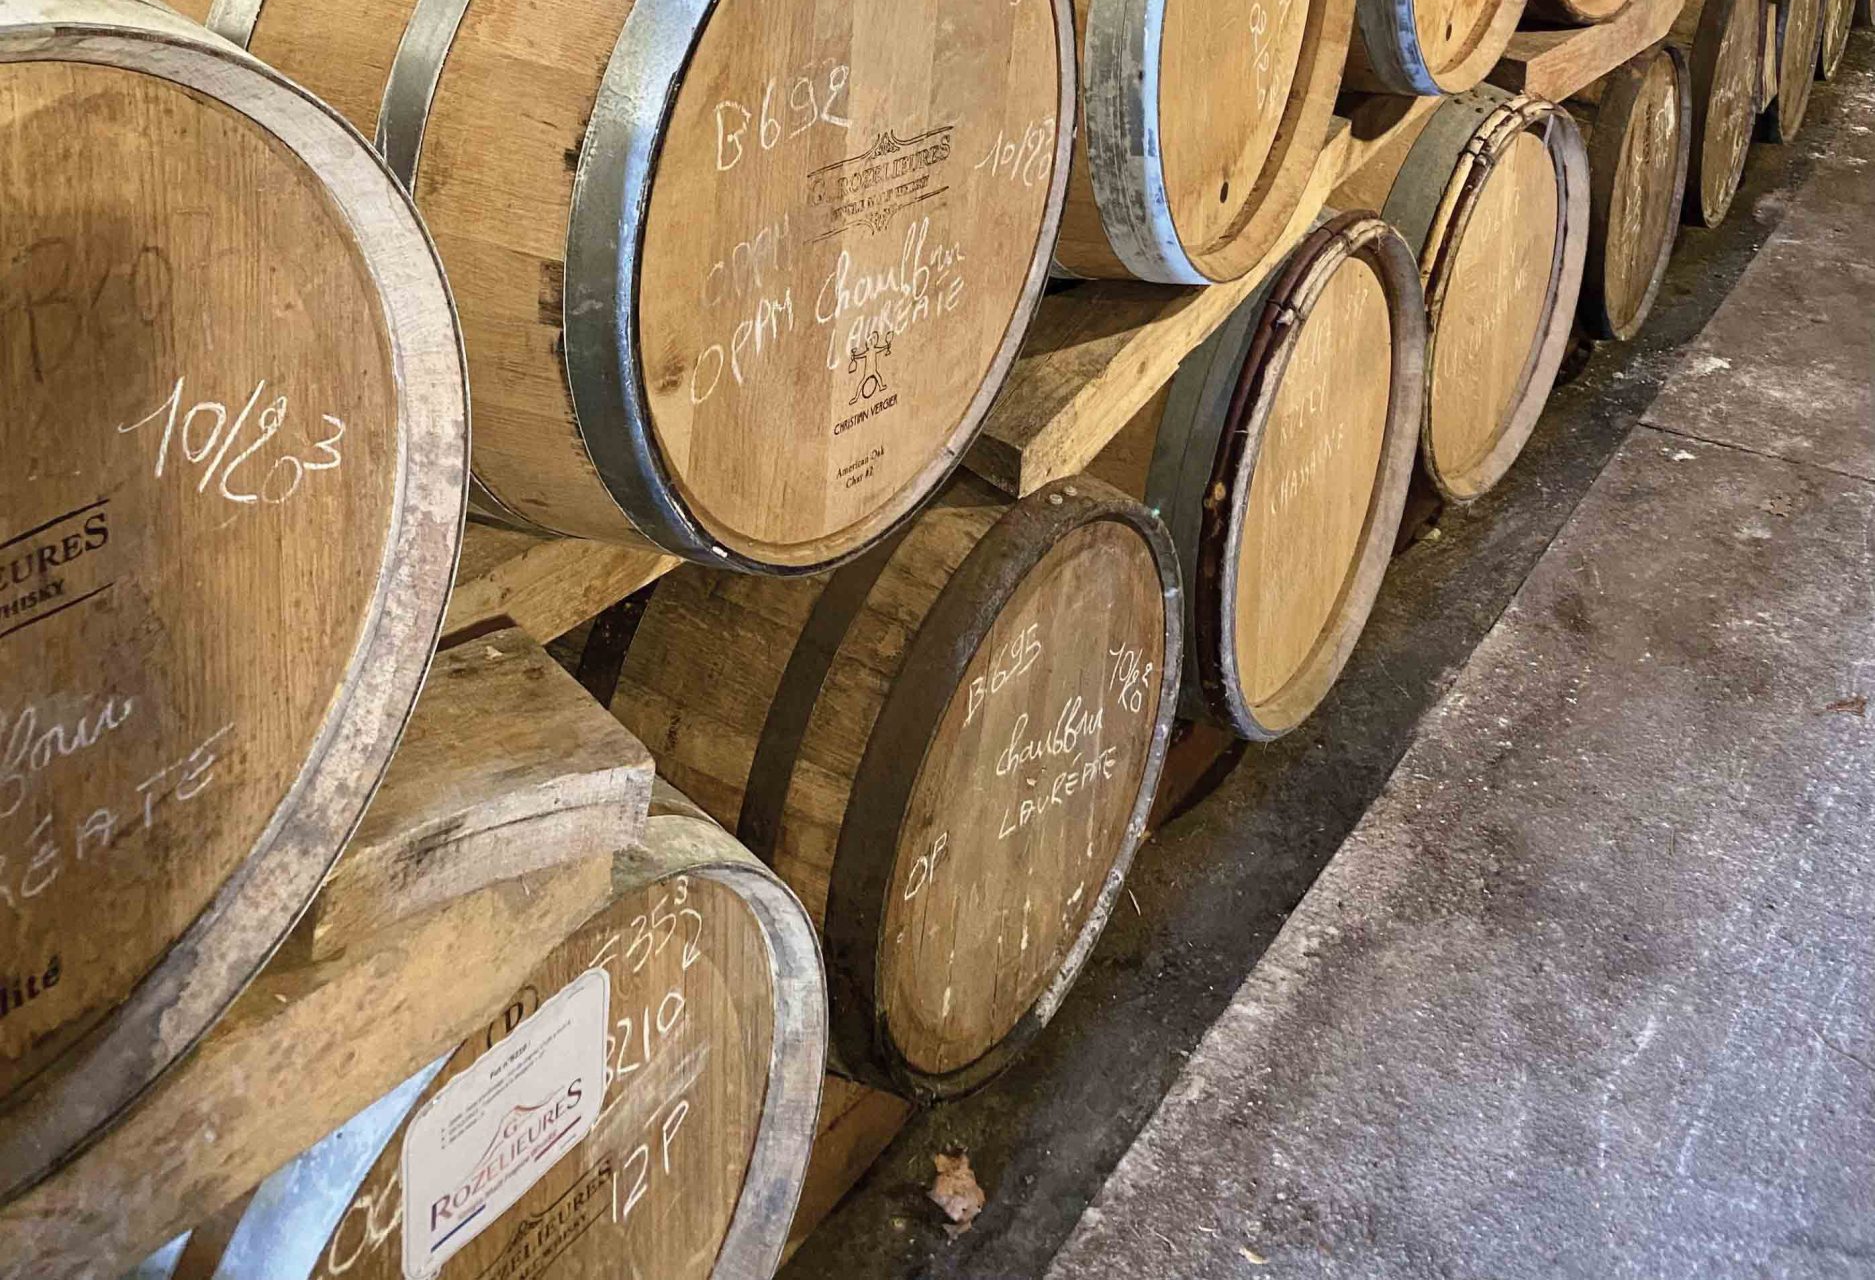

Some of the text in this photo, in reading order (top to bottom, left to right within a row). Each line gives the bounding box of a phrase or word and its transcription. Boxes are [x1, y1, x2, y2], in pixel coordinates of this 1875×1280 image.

[715, 64, 852, 171] B692
[833, 394, 898, 435] CHRISTIAN VERGIER
[836, 457, 869, 480] American
[0, 580, 65, 620] HISKY
[963, 623, 1042, 729] B695
[431, 1077, 582, 1232] ROZELIEURES
